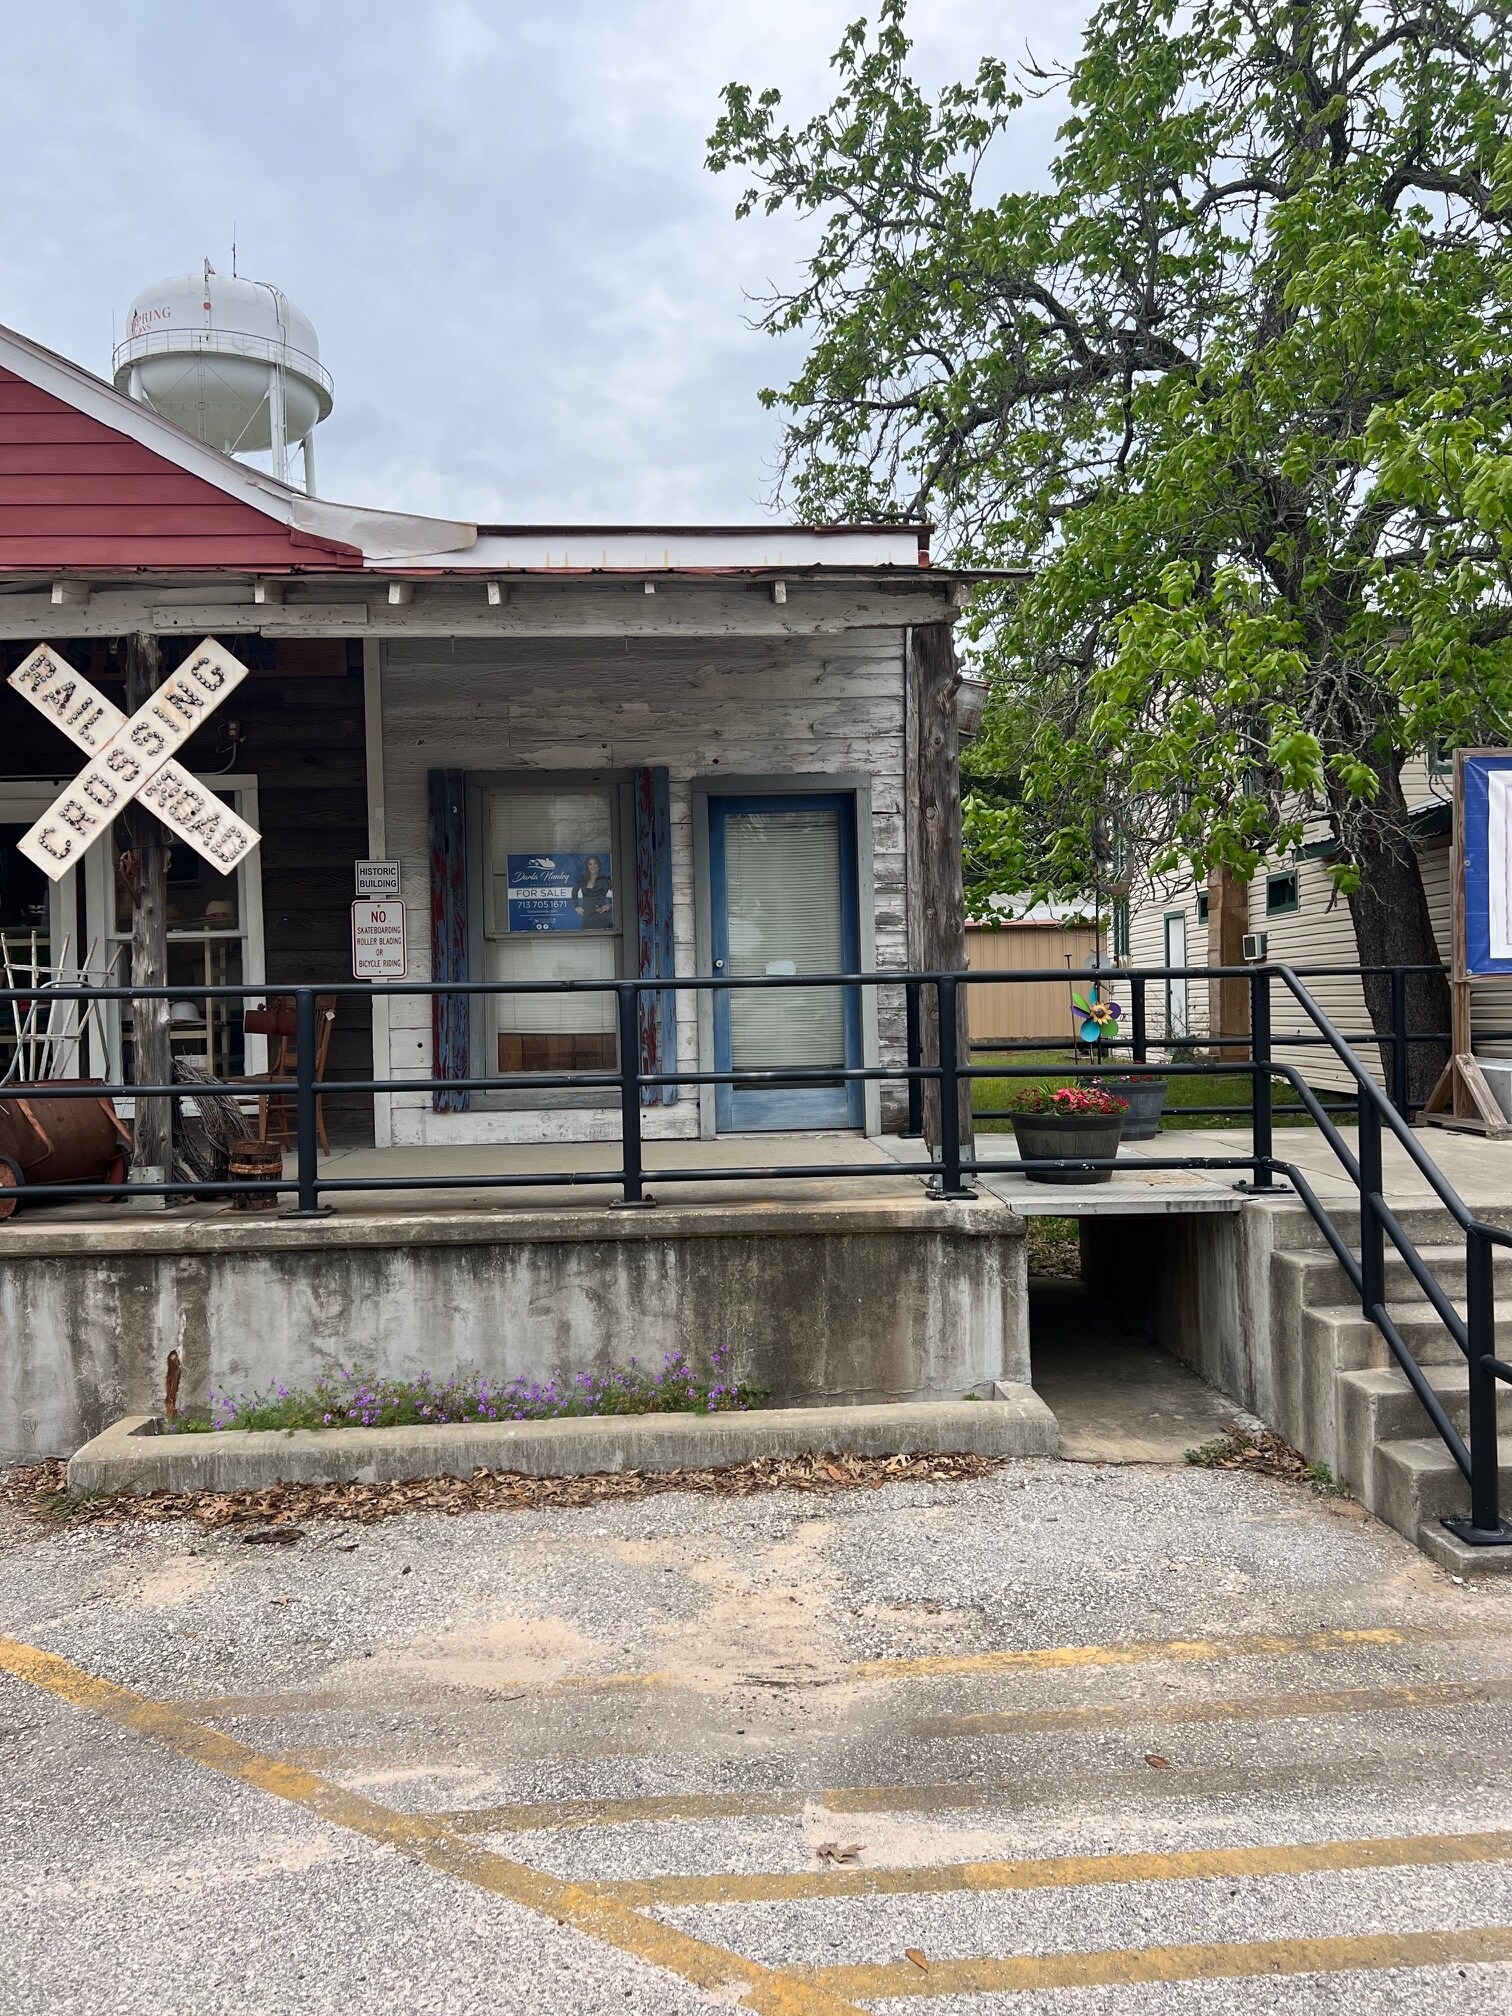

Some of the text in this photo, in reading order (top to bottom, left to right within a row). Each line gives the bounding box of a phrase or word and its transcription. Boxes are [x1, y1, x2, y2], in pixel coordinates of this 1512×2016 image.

[19, 654, 247, 863] RAIL ROAD
[37, 656, 225, 859] CROSSING
[359, 867, 396, 876] HISTORIC
[512, 870, 571, 884] Darla Nunley
[359, 879, 397, 888] BUILDING
[516, 889, 567, 898] FOR SALE
[517, 900, 567, 909] 713.705.1671
[371, 911, 387, 923] NO
[357, 926, 402, 935] SKATEBOARDING
[357, 937, 402, 946] ROLLER BLADING
[375, 948, 383, 957] OR
[358, 960, 381, 968] BICYCLE
